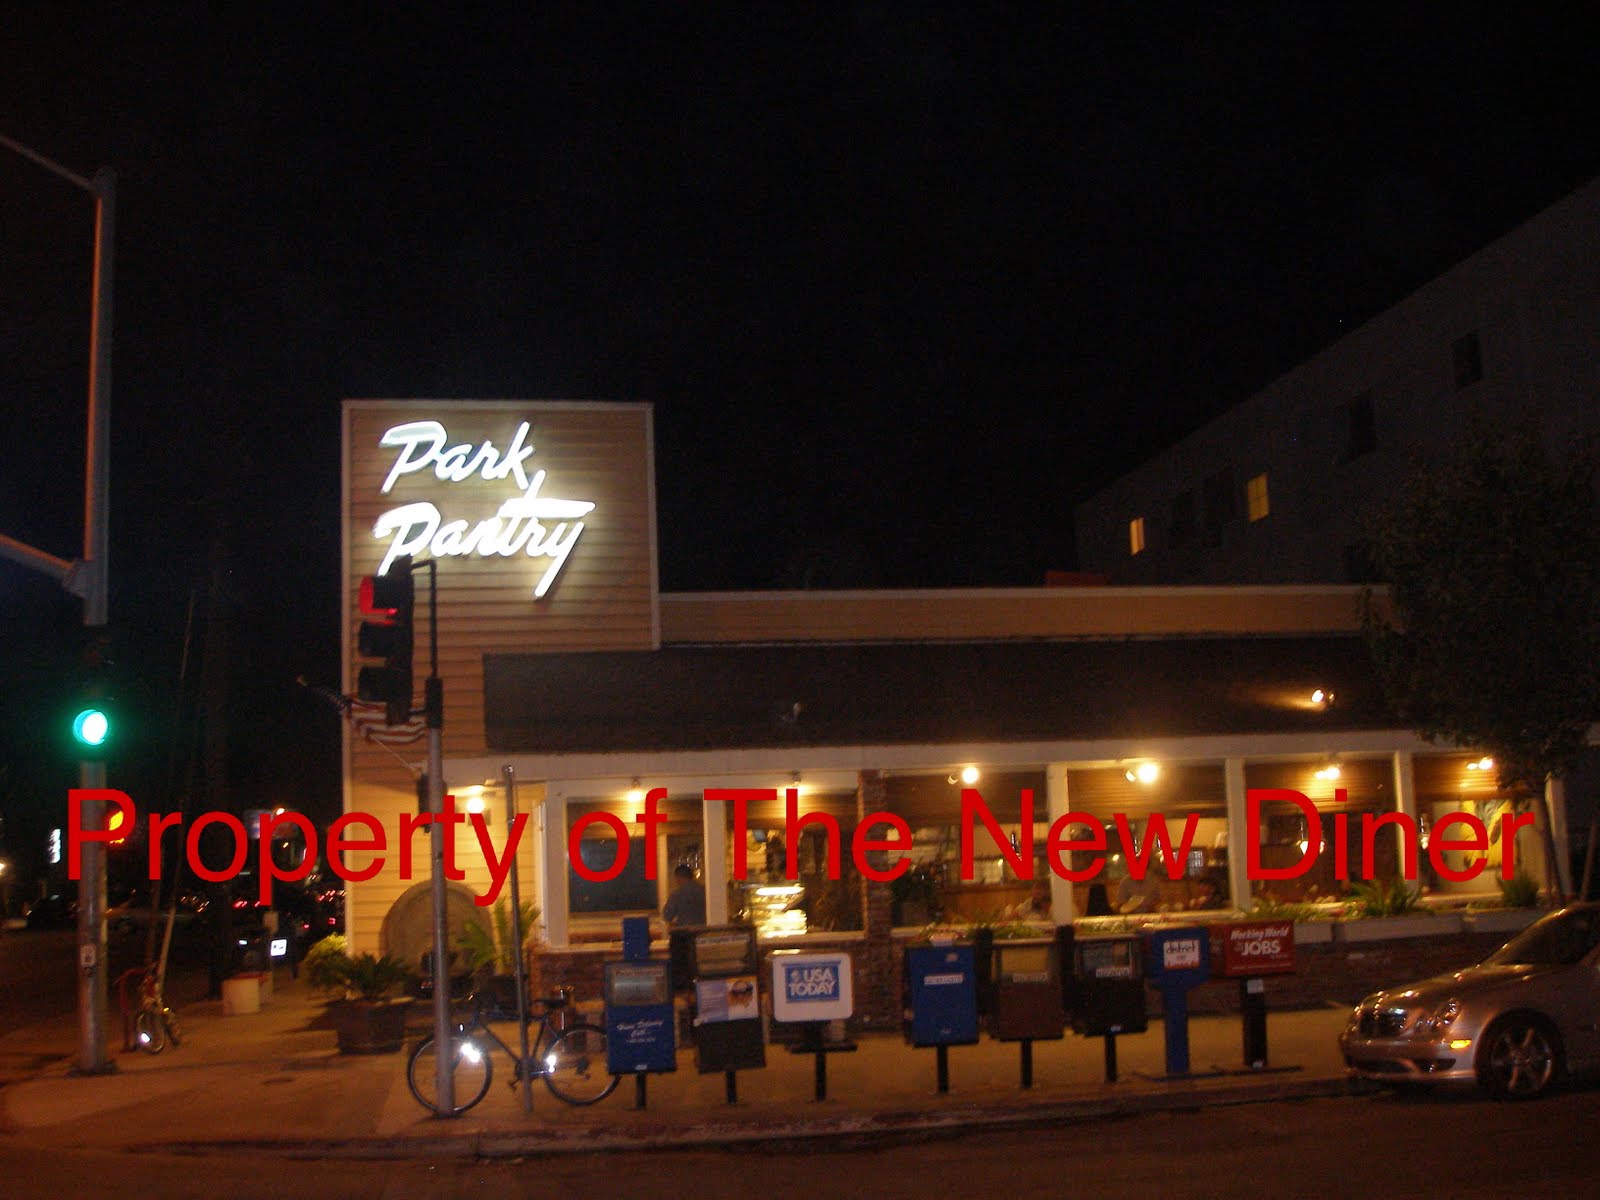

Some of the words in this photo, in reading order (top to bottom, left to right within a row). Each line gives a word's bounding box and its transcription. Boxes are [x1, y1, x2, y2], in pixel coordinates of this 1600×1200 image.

[380, 420, 534, 494] Park
[373, 469, 595, 598] Pantry
[1231, 928, 1265, 941] Working
[1264, 925, 1290, 938] World
[1241, 940, 1281, 956] JOBS
[803, 968, 834, 982] USA
[788, 980, 836, 997] TODAY
